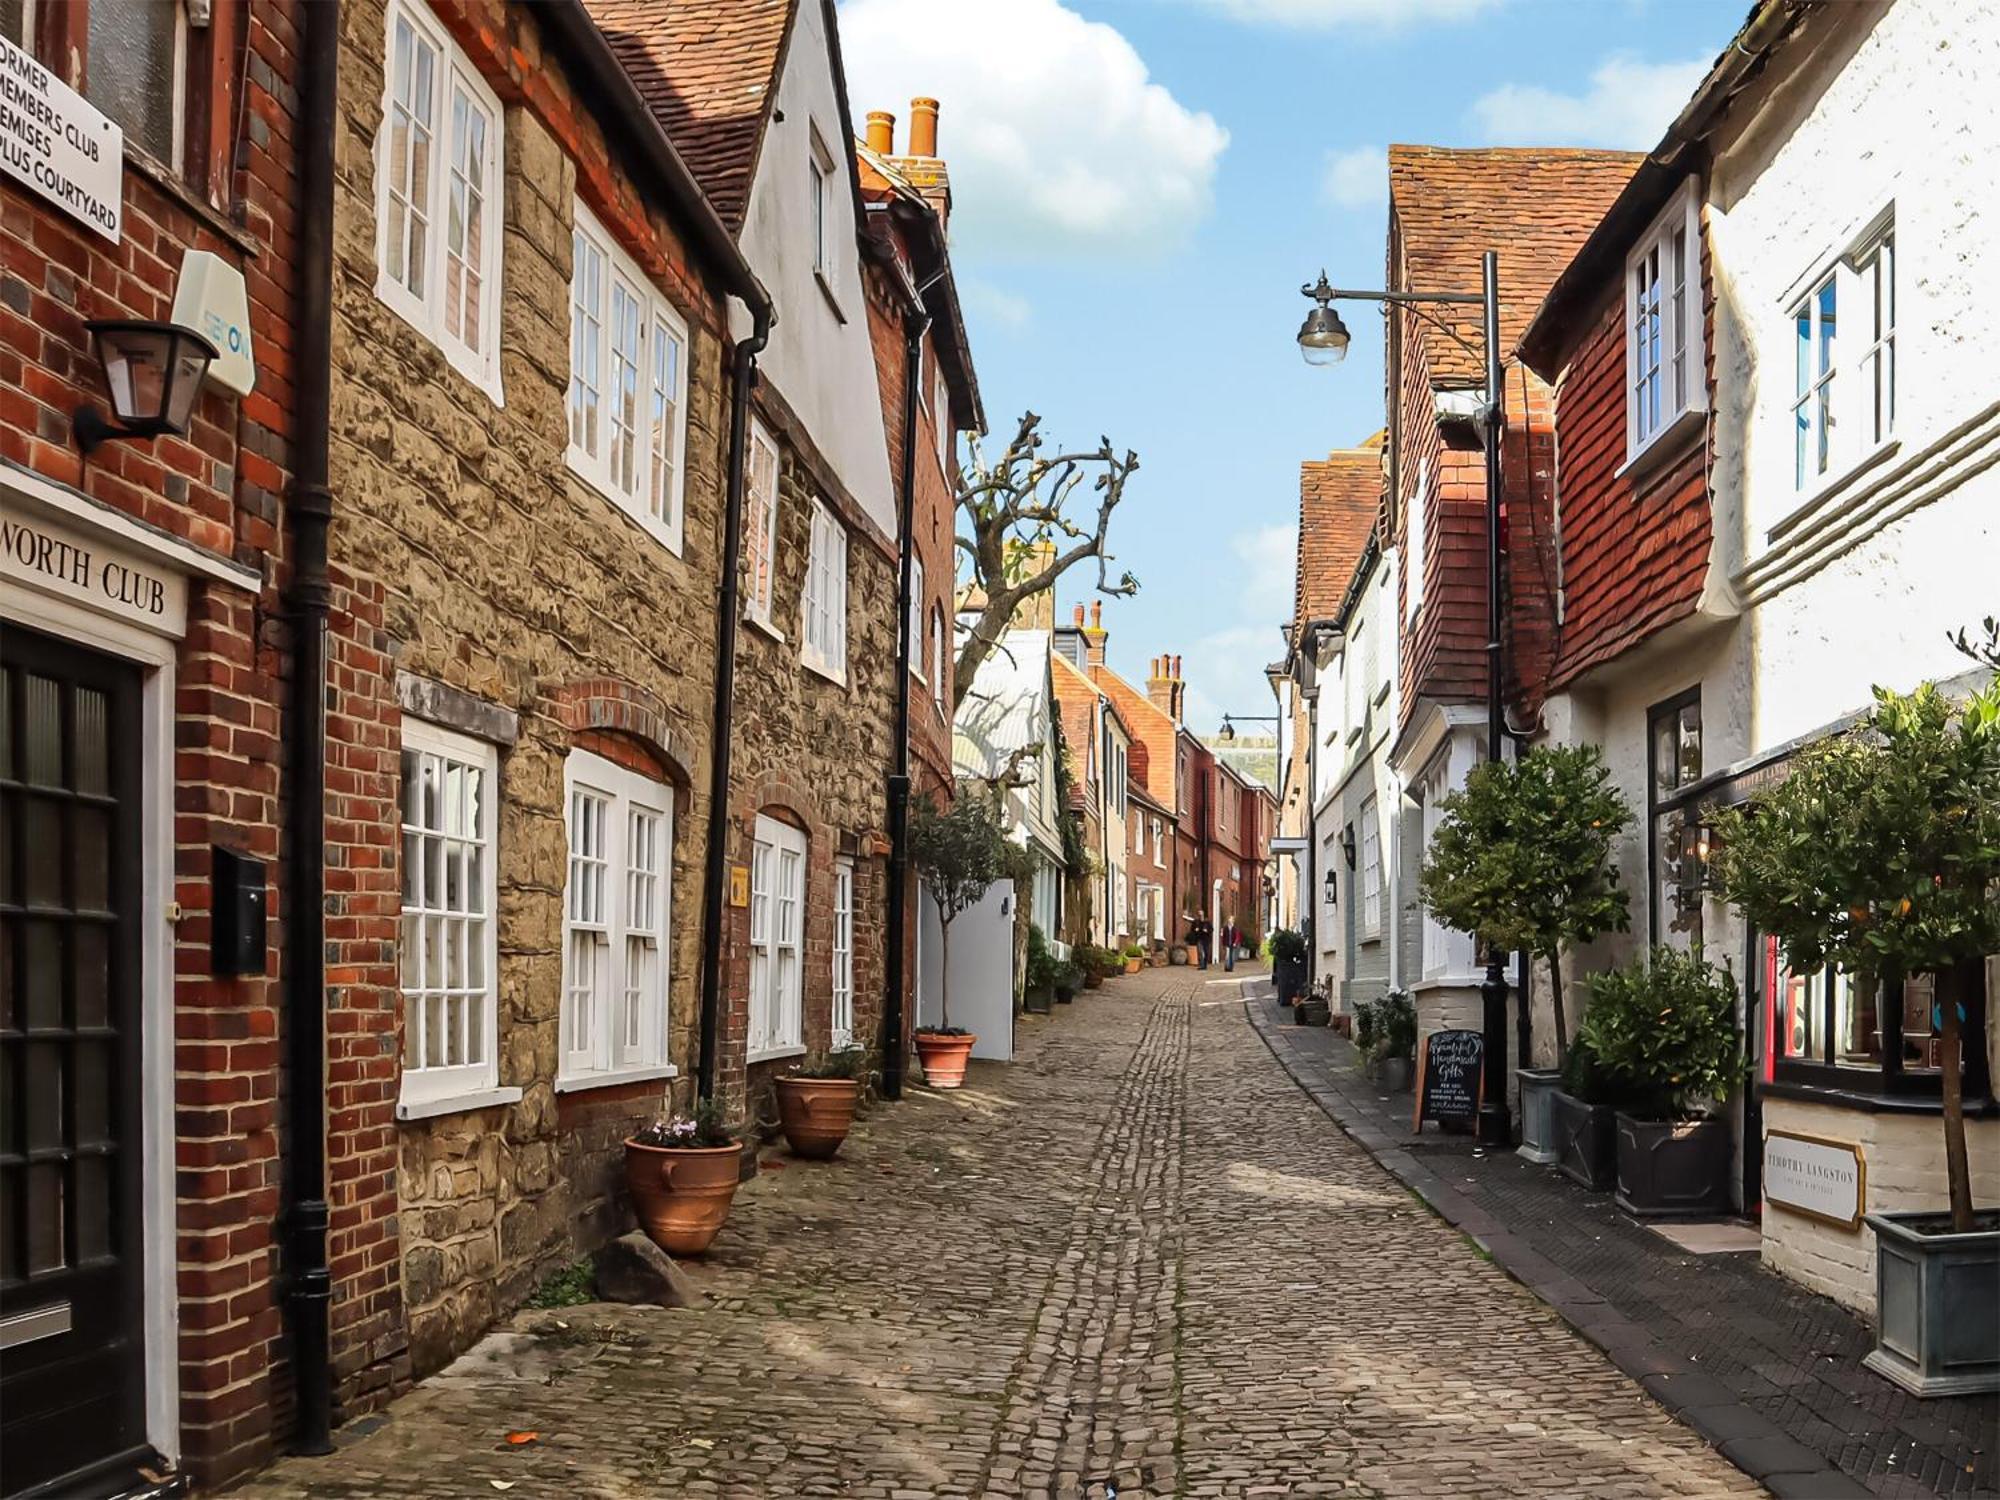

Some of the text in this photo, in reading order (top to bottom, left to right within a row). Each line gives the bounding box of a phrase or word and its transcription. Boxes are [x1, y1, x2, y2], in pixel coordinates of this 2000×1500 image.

[0, 104, 52, 157] EMISES
[66, 123, 99, 162] CLUB
[34, 161, 116, 231] COURTYARD
[102, 562, 164, 615] CLUB
[1438, 1063, 1464, 1082] Gifts
[1807, 1163, 1854, 1184] LANGSTON
